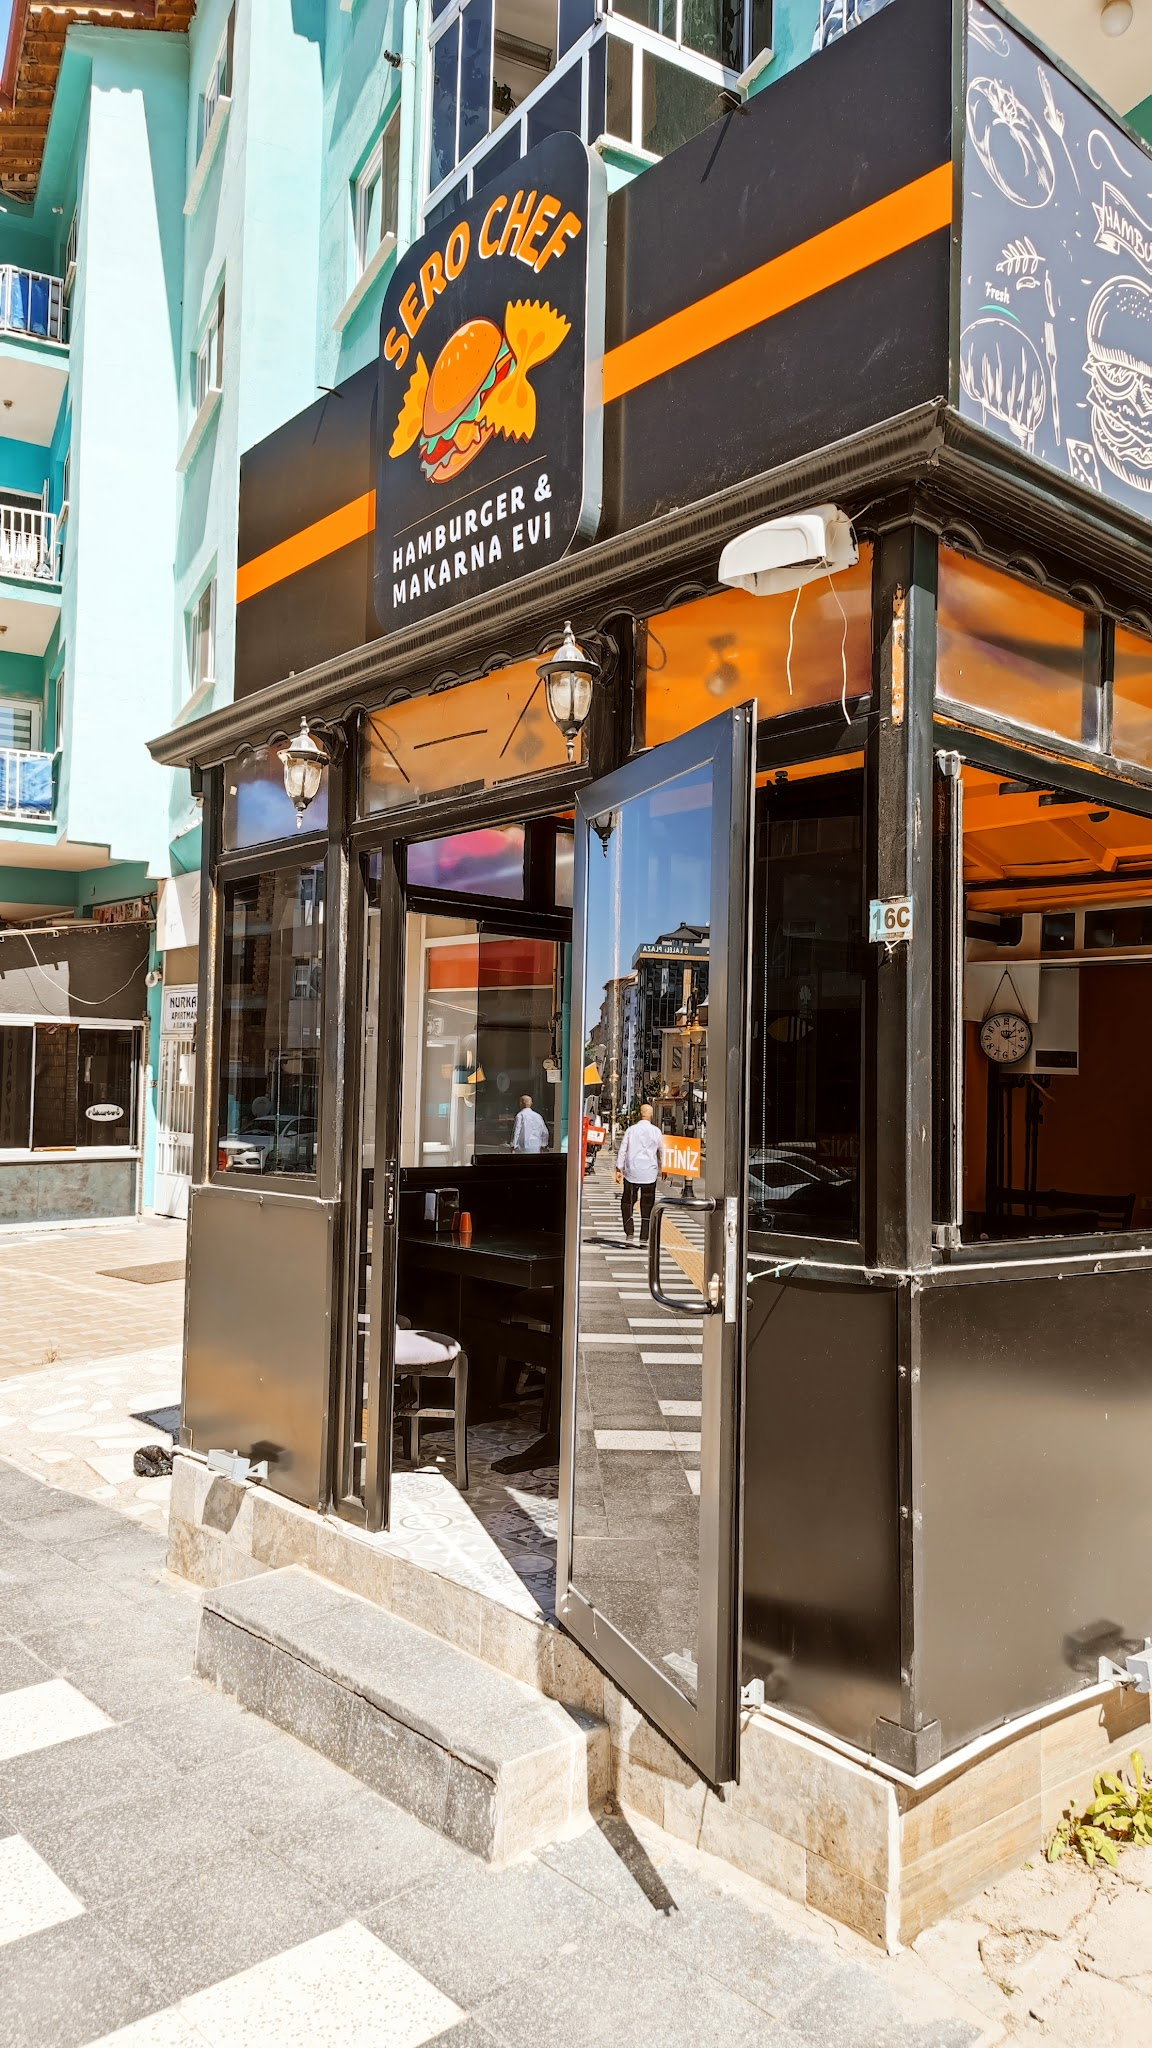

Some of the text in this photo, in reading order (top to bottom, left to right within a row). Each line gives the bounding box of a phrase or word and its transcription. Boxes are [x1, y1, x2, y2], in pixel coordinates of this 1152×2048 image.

[384, 189, 582, 371] SERO CHEF
[984, 281, 1011, 305] Fresh
[392, 474, 552, 574] HAMBURGER &
[392, 534, 502, 609] MAKARNA
[872, 906, 911, 930] 16C
